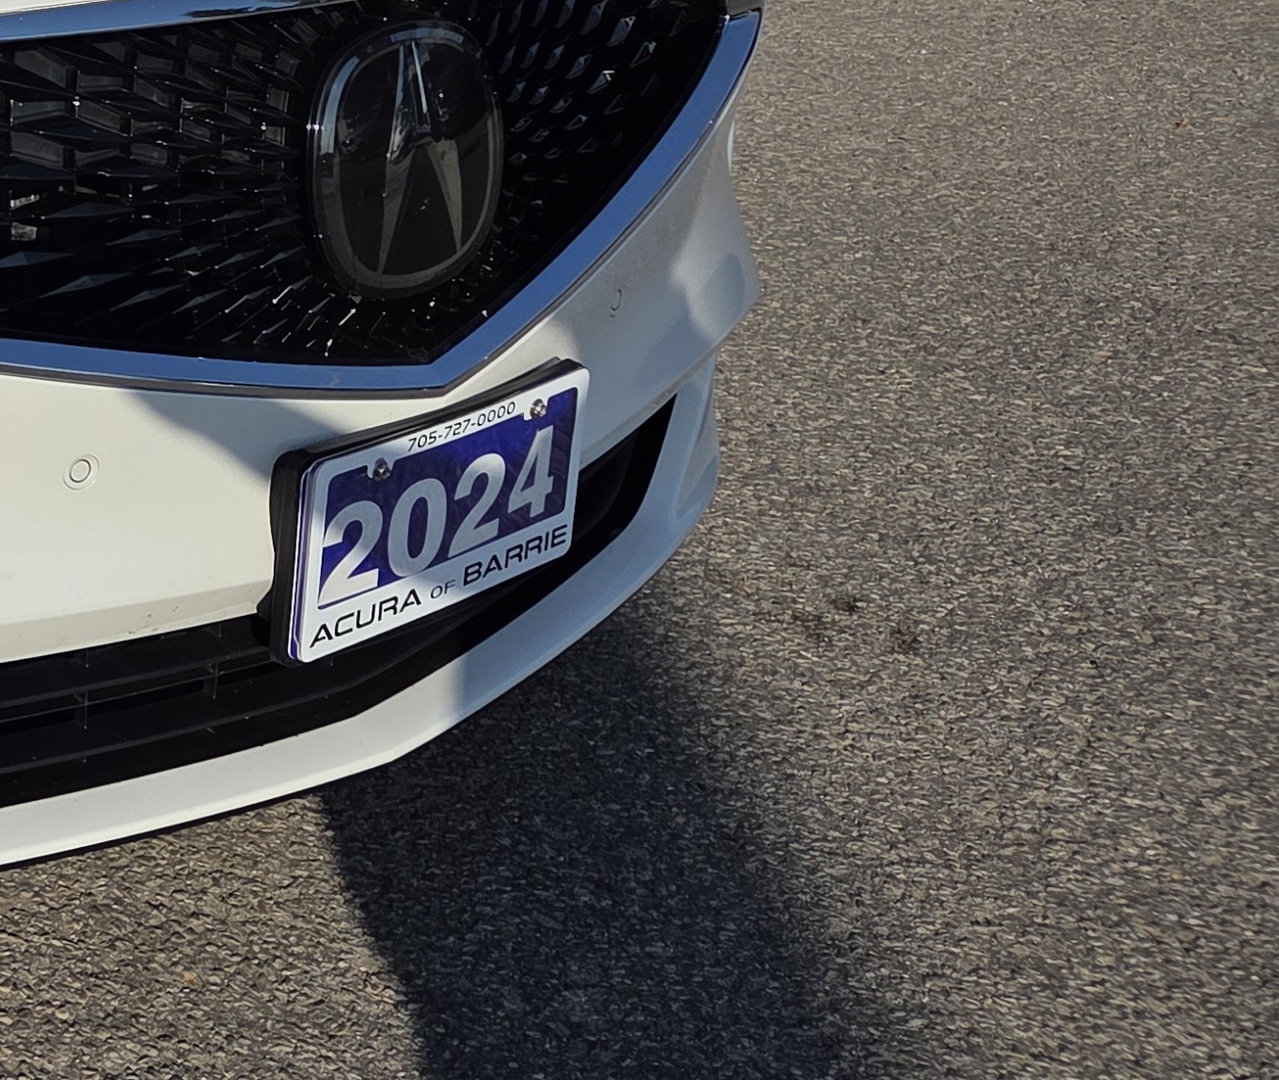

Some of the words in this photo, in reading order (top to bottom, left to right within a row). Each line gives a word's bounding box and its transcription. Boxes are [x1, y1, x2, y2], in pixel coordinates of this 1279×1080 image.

[407, 401, 516, 452] 705-727-0000
[318, 425, 554, 605] 2024
[309, 588, 422, 649] ACURA
[430, 579, 456, 600] OF
[463, 523, 568, 587] BARRIE
